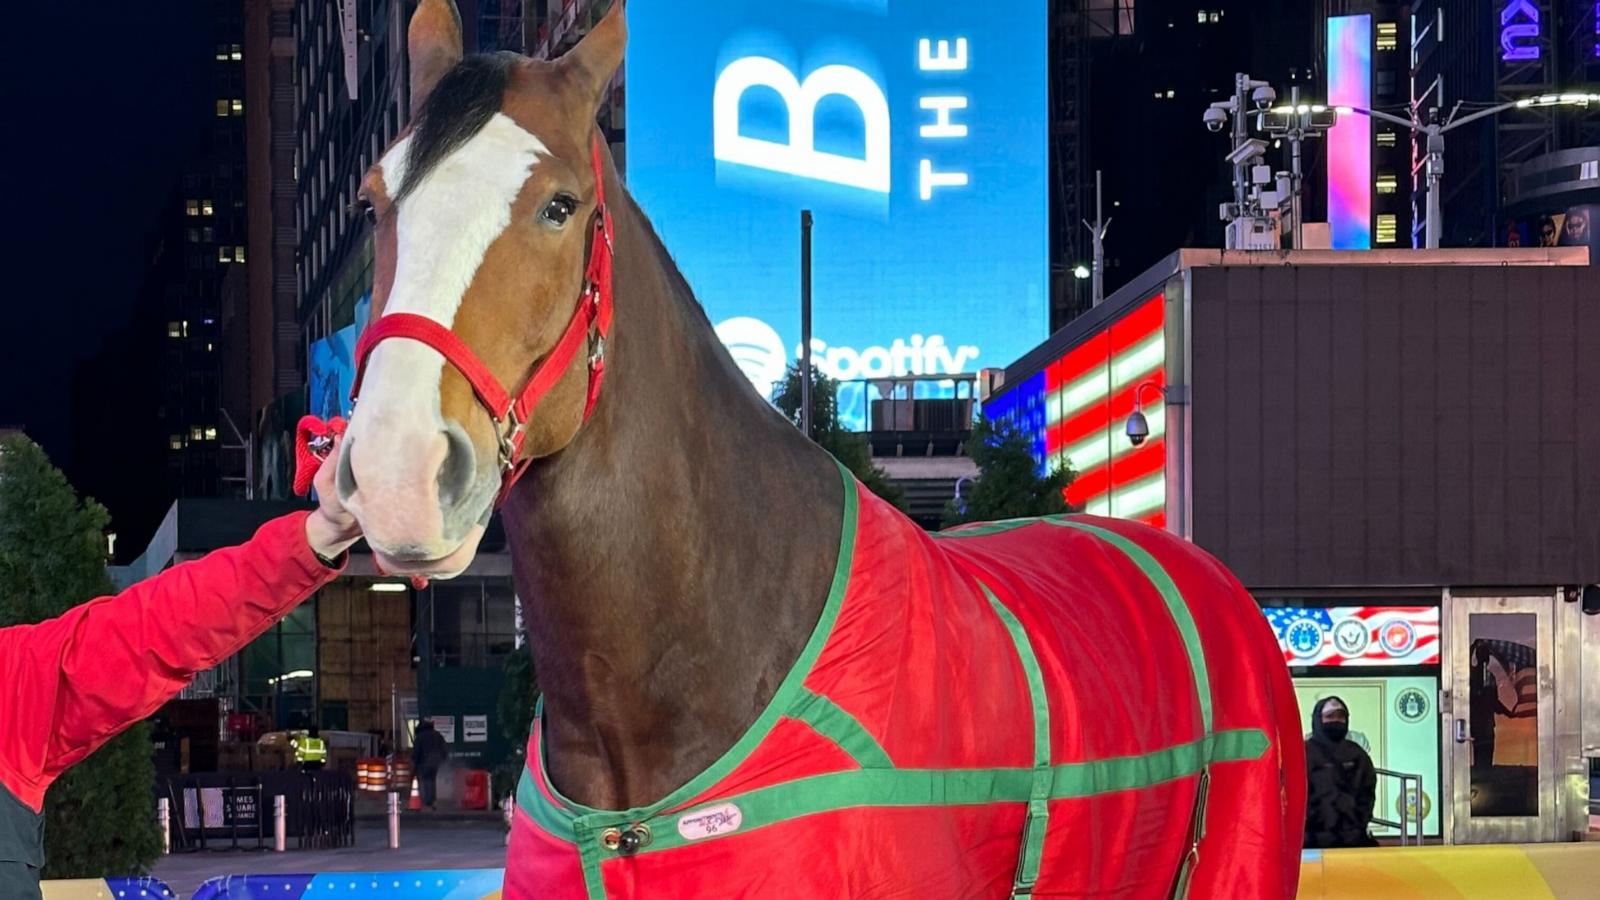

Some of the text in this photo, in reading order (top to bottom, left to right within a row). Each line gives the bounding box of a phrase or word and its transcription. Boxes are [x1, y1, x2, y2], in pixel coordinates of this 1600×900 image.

[918, 37, 969, 200] THE
[796, 333, 969, 379] Spotify
[226, 804, 256, 812] SUARE
